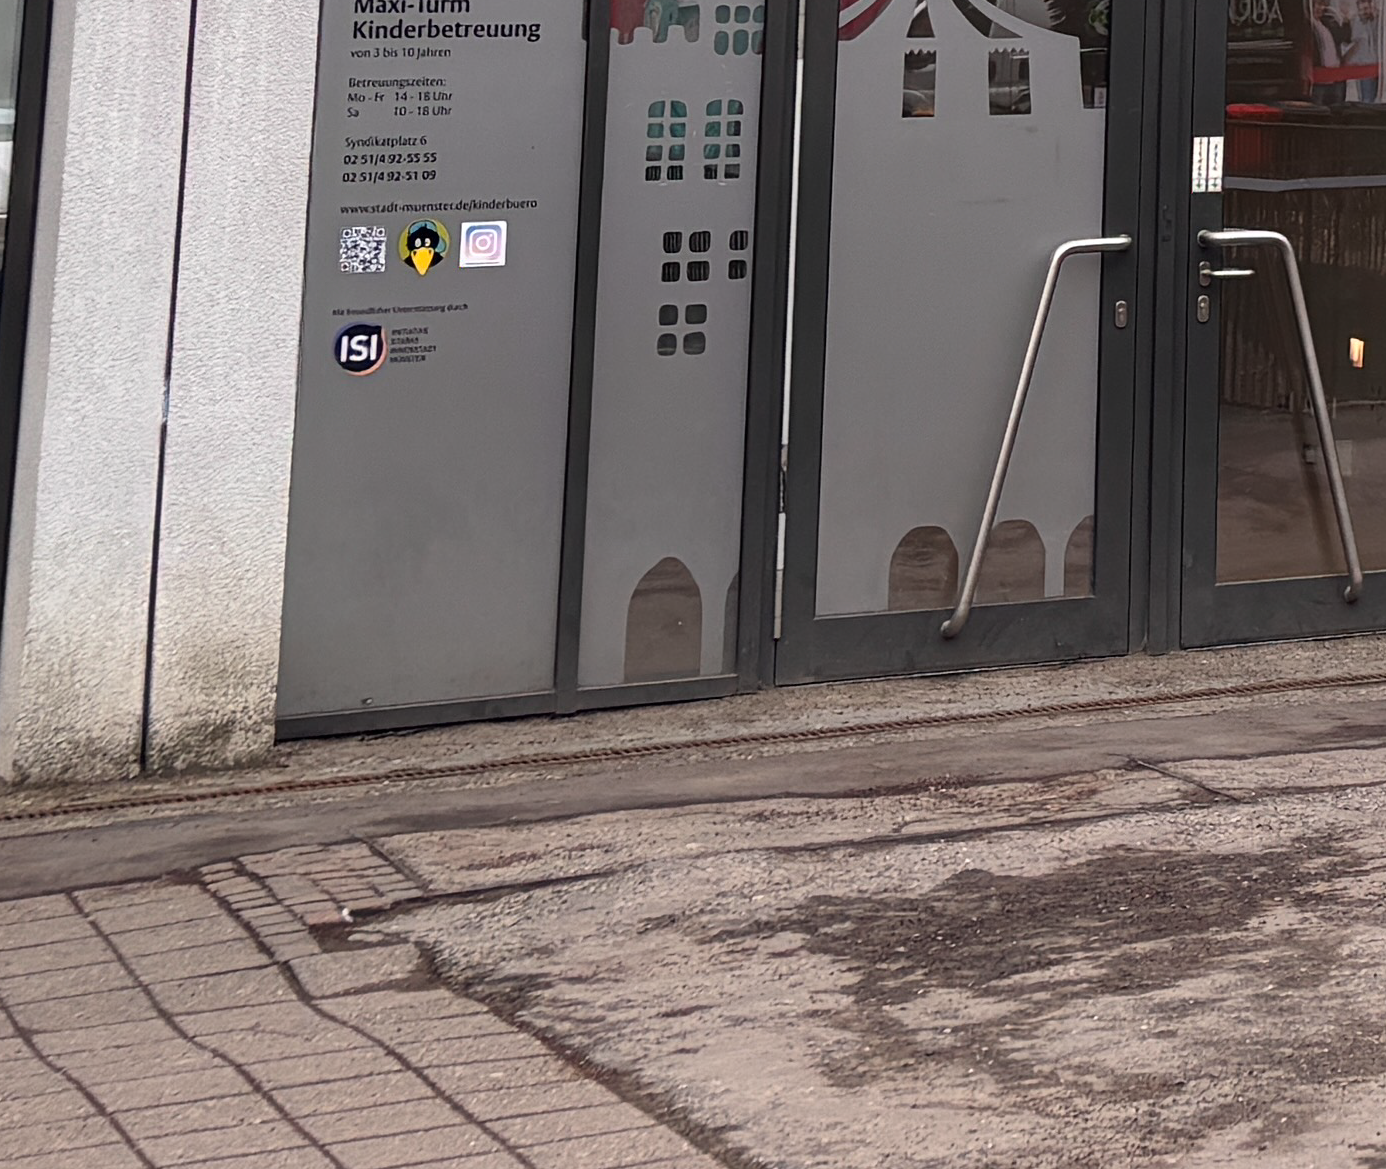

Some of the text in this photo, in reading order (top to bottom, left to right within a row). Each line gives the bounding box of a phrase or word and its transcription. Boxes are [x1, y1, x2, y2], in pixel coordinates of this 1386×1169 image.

[352, 18, 542, 42] Kinderbetreuung
[350, 46, 452, 60] von 3 bis 10 Jahren
[347, 92, 366, 102] Mo
[374, 91, 386, 102] Fr
[395, 91, 408, 101] 14
[433, 90, 453, 101] Uhr
[346, 106, 360, 118] Sa
[394, 106, 407, 116] 10
[417, 105, 430, 116] 18
[432, 105, 453, 116] Uhr
[344, 135, 428, 150] Syndikatplatz 6
[343, 154, 359, 165] 02
[360, 153, 386, 166] 51/4
[423, 152, 438, 163] 55
[342, 172, 358, 183] 02
[359, 171, 385, 184] 51/4
[421, 169, 437, 181] 09
[339, 333, 379, 363] ISI
